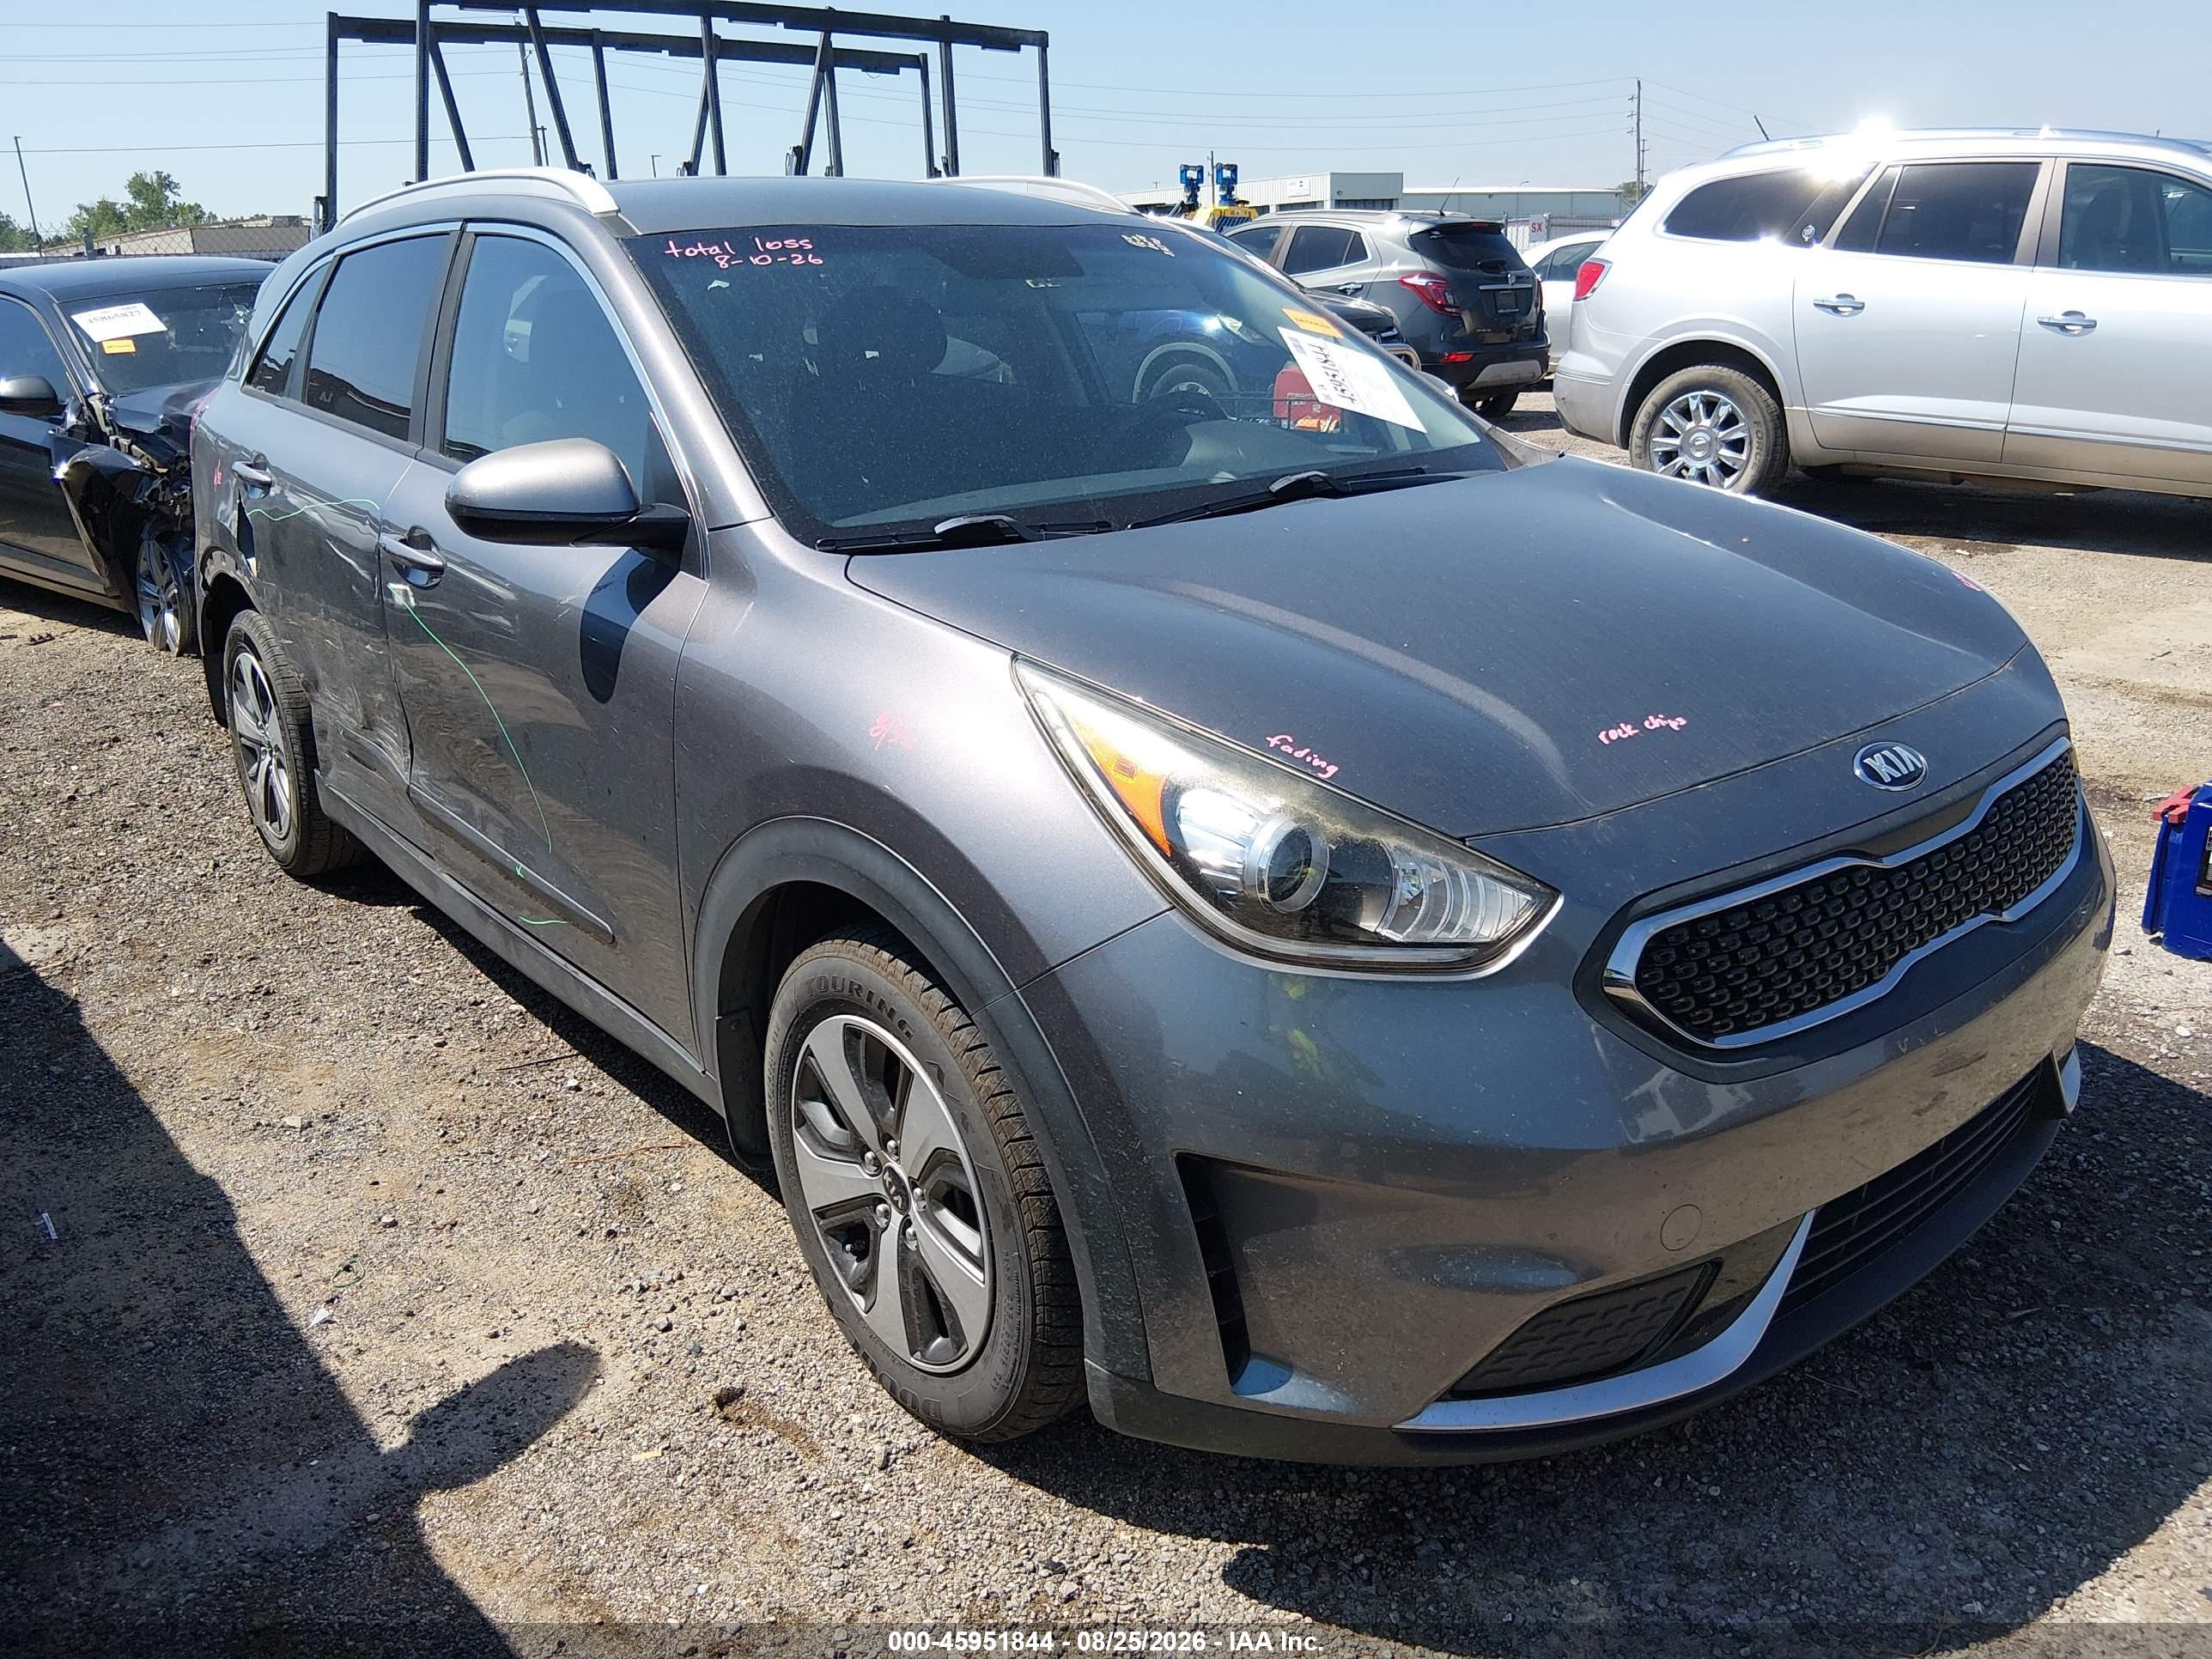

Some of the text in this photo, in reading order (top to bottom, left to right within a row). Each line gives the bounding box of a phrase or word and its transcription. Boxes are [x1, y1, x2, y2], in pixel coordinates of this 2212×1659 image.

[1531, 222, 1542, 233] SX
[665, 237, 813, 258] total loss
[714, 253, 824, 269] 8-10-26
[1751, 420, 1765, 470] FORCE
[1266, 735, 1339, 779] fading
[1863, 746, 1923, 783] KIA
[805, 975, 915, 1041] TOURING
[884, 1170, 902, 1209] KIA
